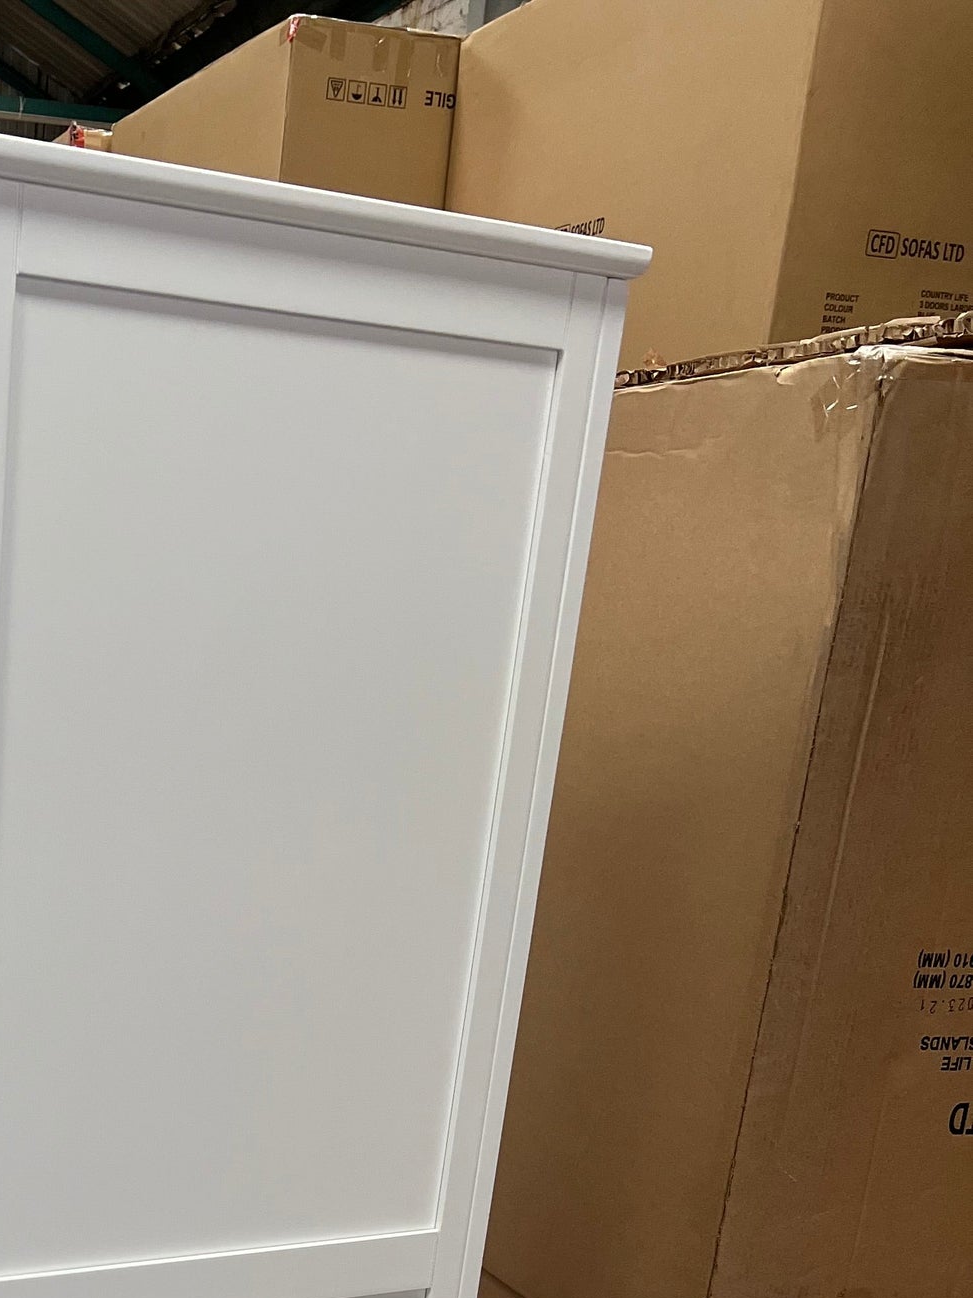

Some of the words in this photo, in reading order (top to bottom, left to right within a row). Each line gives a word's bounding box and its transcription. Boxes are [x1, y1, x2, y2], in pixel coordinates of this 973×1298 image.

[870, 234, 896, 254] CFD
[900, 238, 941, 260] SOFAS
[943, 243, 965, 262] LTD
[826, 293, 859, 303] PRODUCT
[921, 290, 953, 300] COUNTRY
[954, 293, 969, 302] LIFE
[824, 303, 853, 314] COLOUR
[822, 315, 846, 324] BATCH
[918, 949, 951, 968] (MM)
[913, 970, 946, 989] (MM)
[940, 1056, 972, 1071] LIFE
